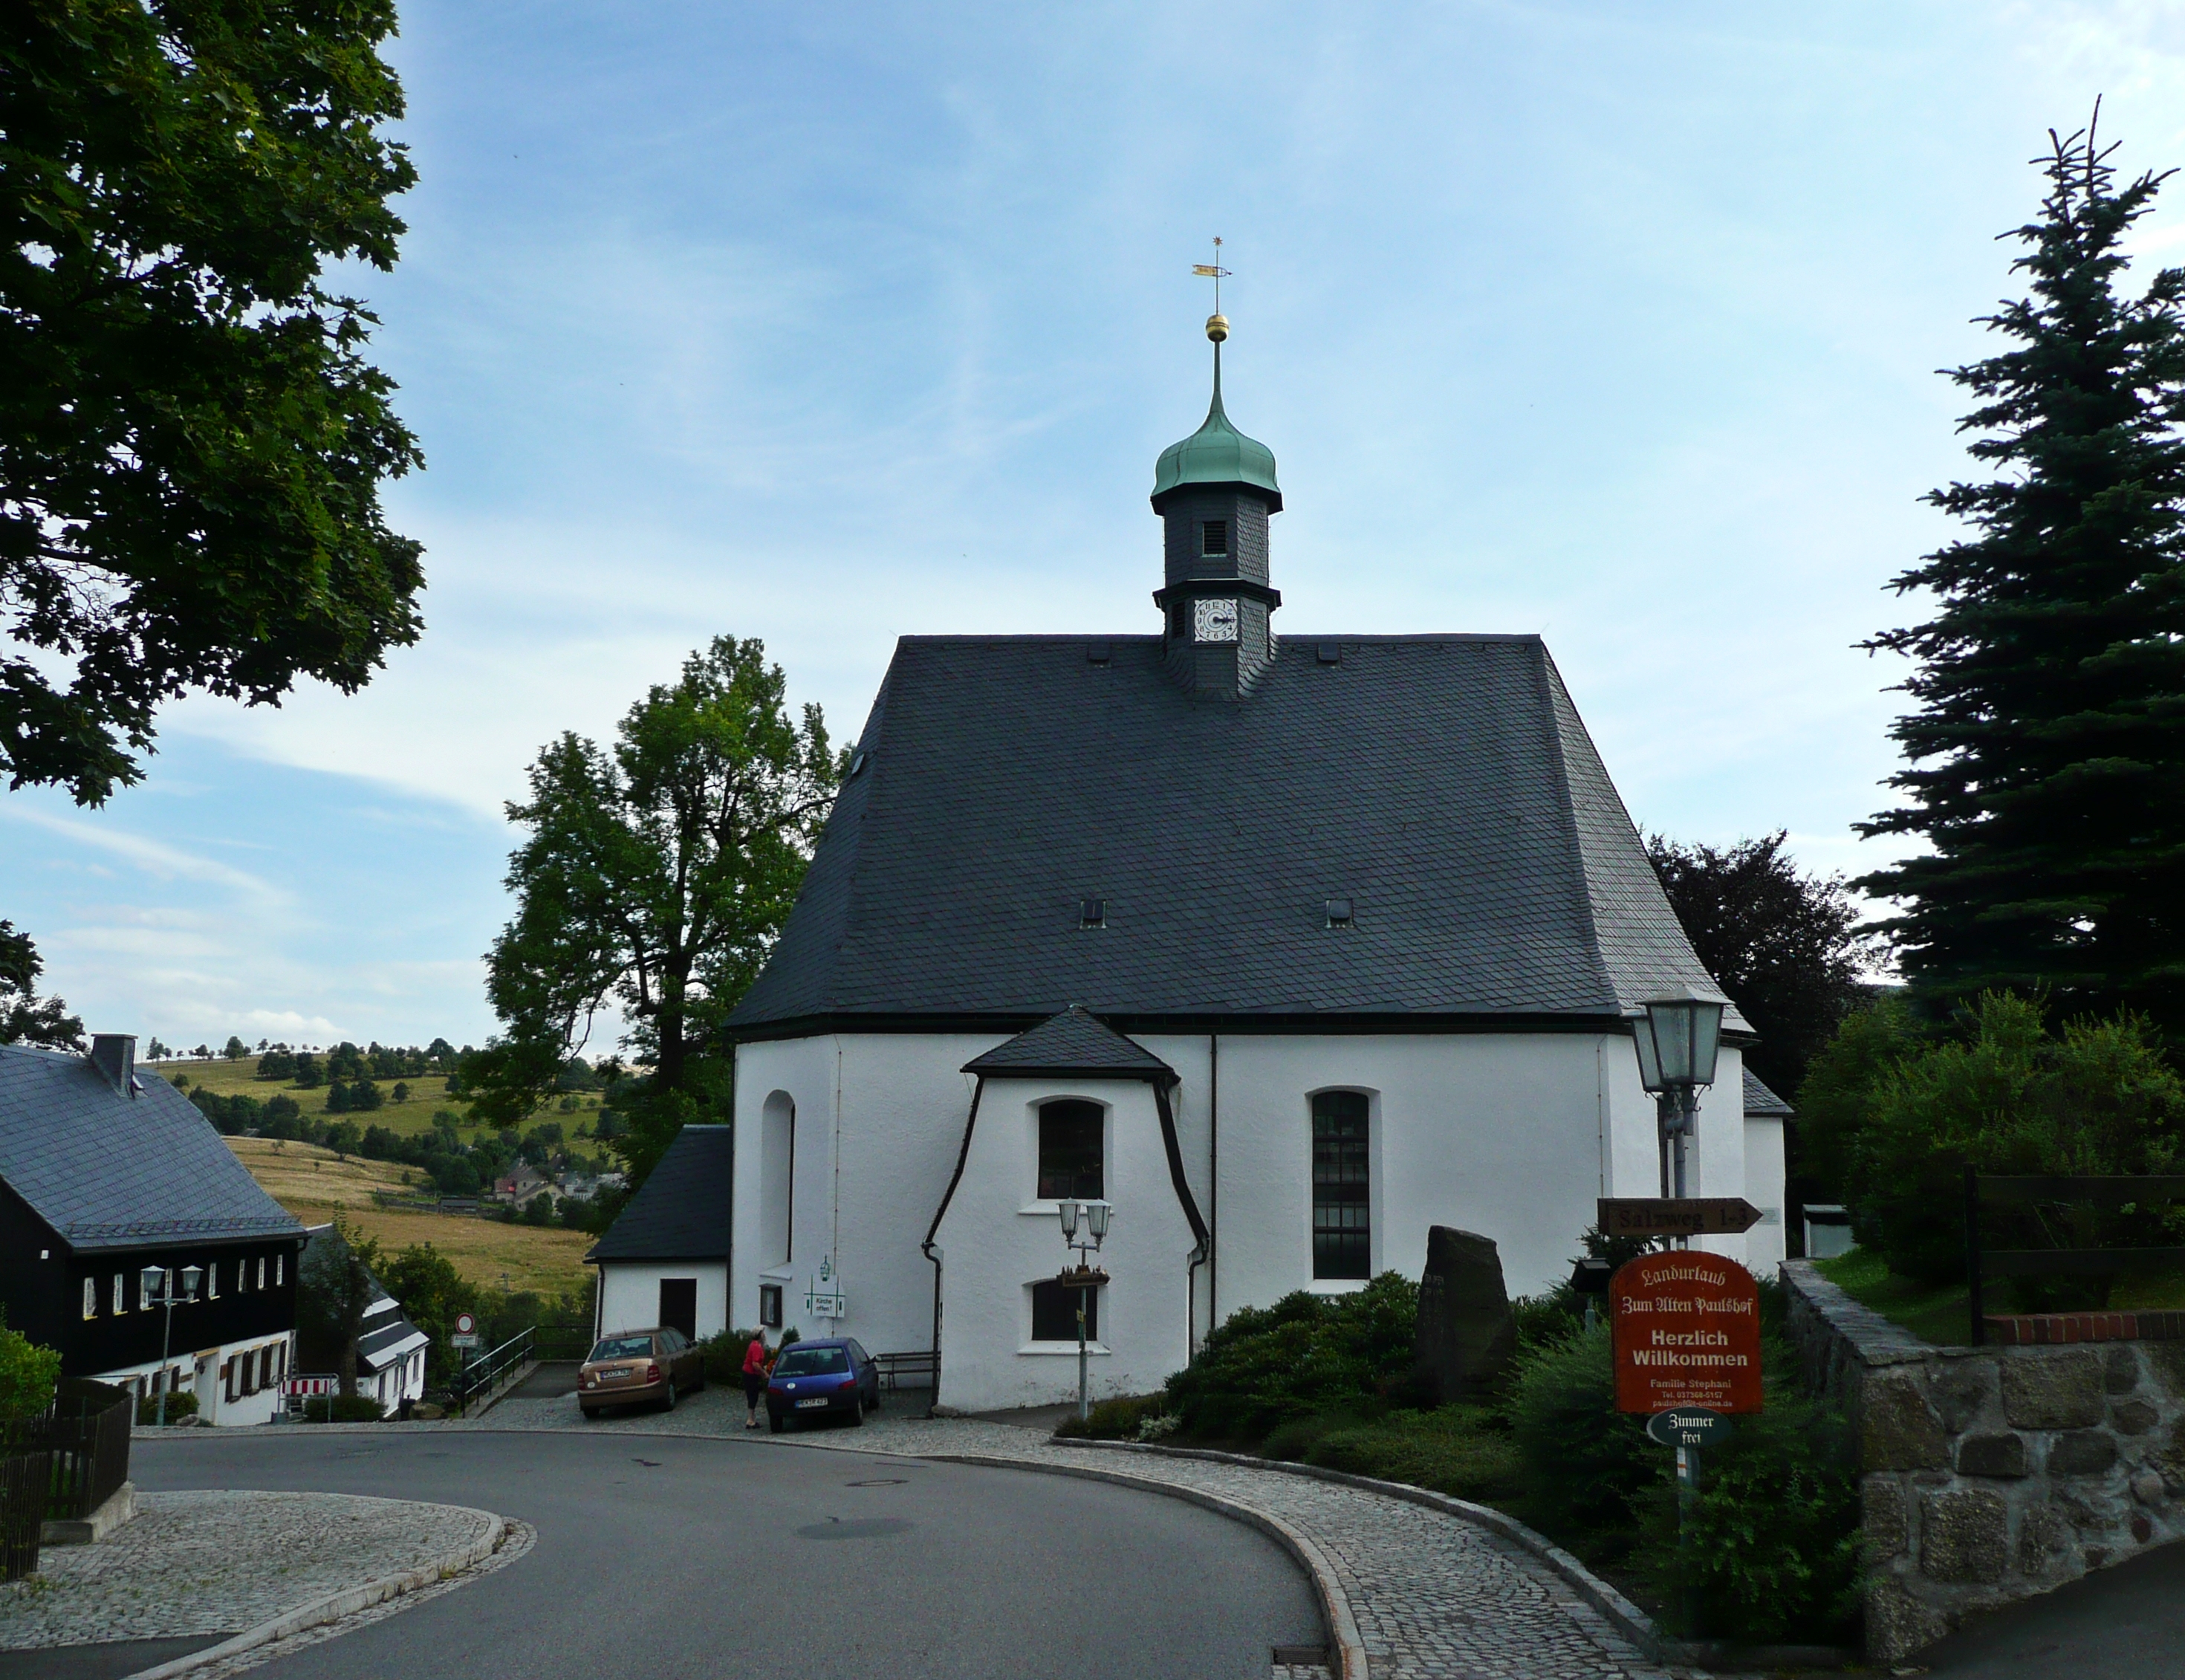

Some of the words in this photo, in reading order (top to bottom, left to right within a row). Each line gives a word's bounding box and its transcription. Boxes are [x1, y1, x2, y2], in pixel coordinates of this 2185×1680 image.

[1619, 1209, 1705, 1231] Salzweg
[1718, 1207, 1748, 1226] 1-3
[1641, 1265, 1726, 1288] Landurlaub
[1621, 1296, 1654, 1314] Zum
[1655, 1297, 1692, 1313] Alten
[1695, 1297, 1754, 1316] Paulshof
[1651, 1329, 1729, 1346] Herzlich
[1632, 1349, 1748, 1366] Willkommen
[1650, 1379, 1686, 1388] Familie
[1689, 1379, 1732, 1390] Stephani
[1668, 1413, 1715, 1430] Zimmer
[1681, 1430, 1701, 1445] frei
